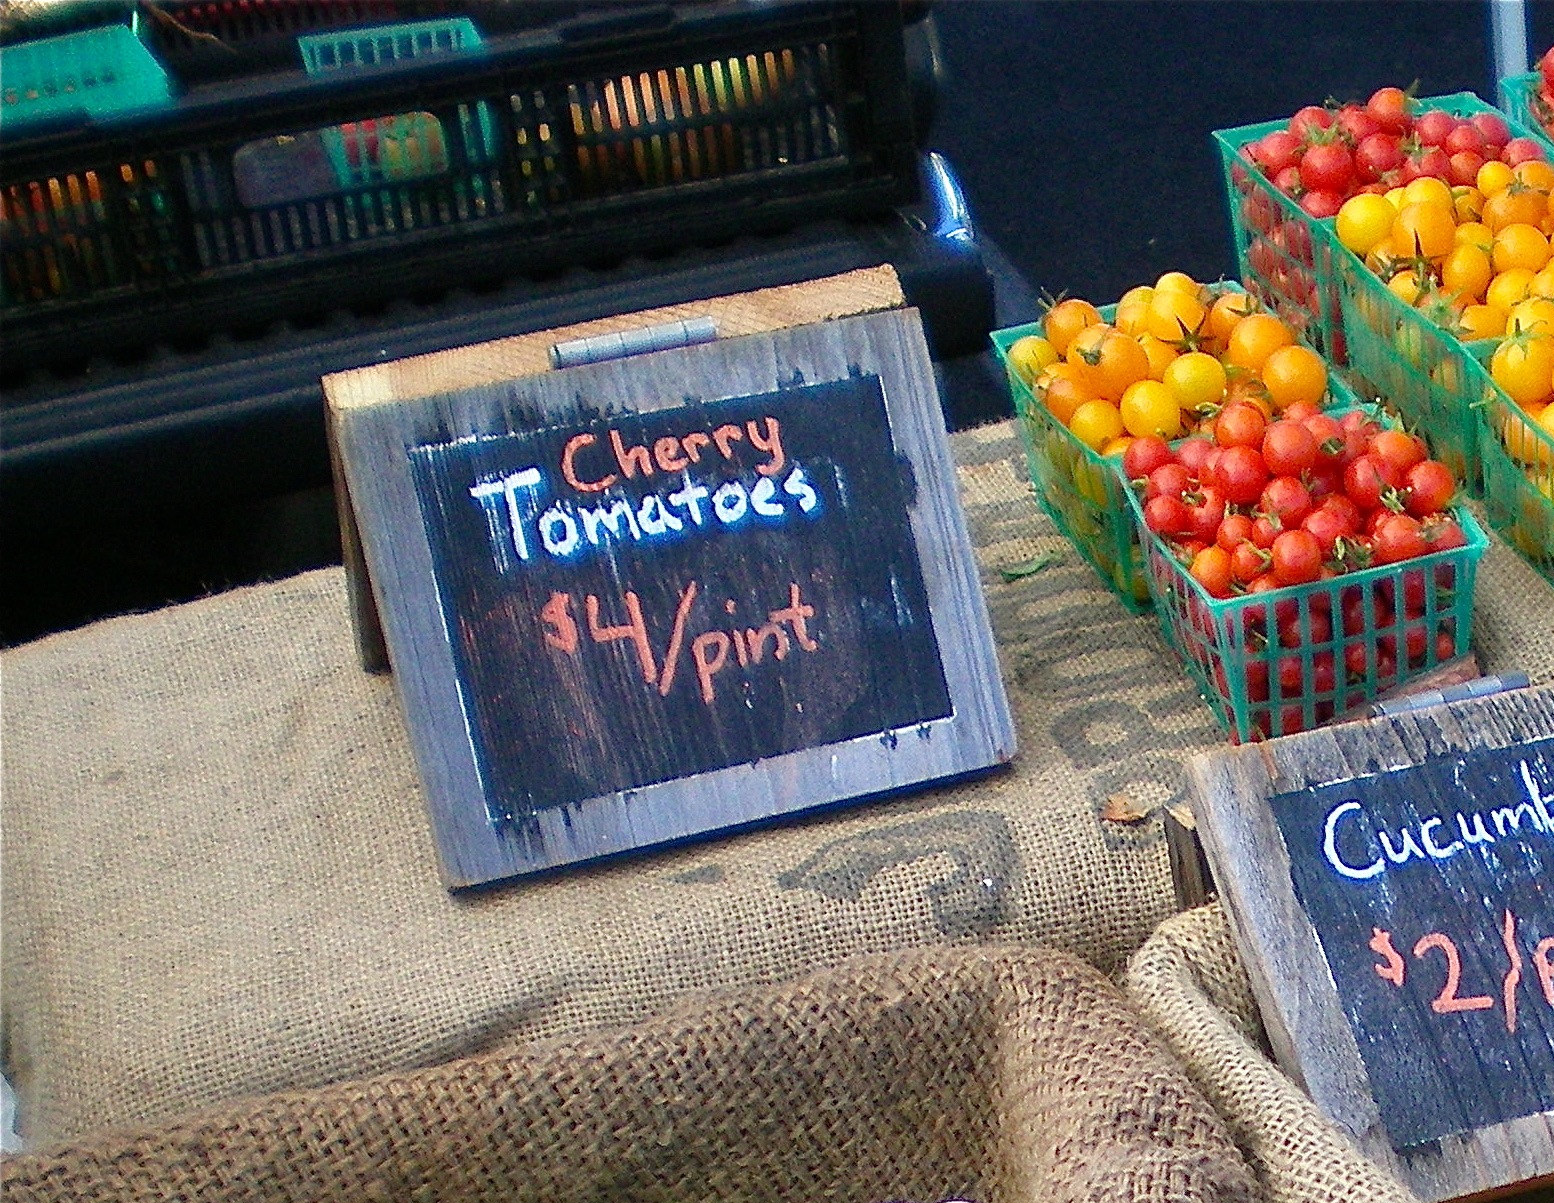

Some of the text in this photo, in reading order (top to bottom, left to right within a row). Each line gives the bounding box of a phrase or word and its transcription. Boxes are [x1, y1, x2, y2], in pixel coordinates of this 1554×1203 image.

[561, 416, 786, 493] Cherry
[470, 464, 818, 561] Tomatoes
[540, 582, 818, 703] $4/pint
